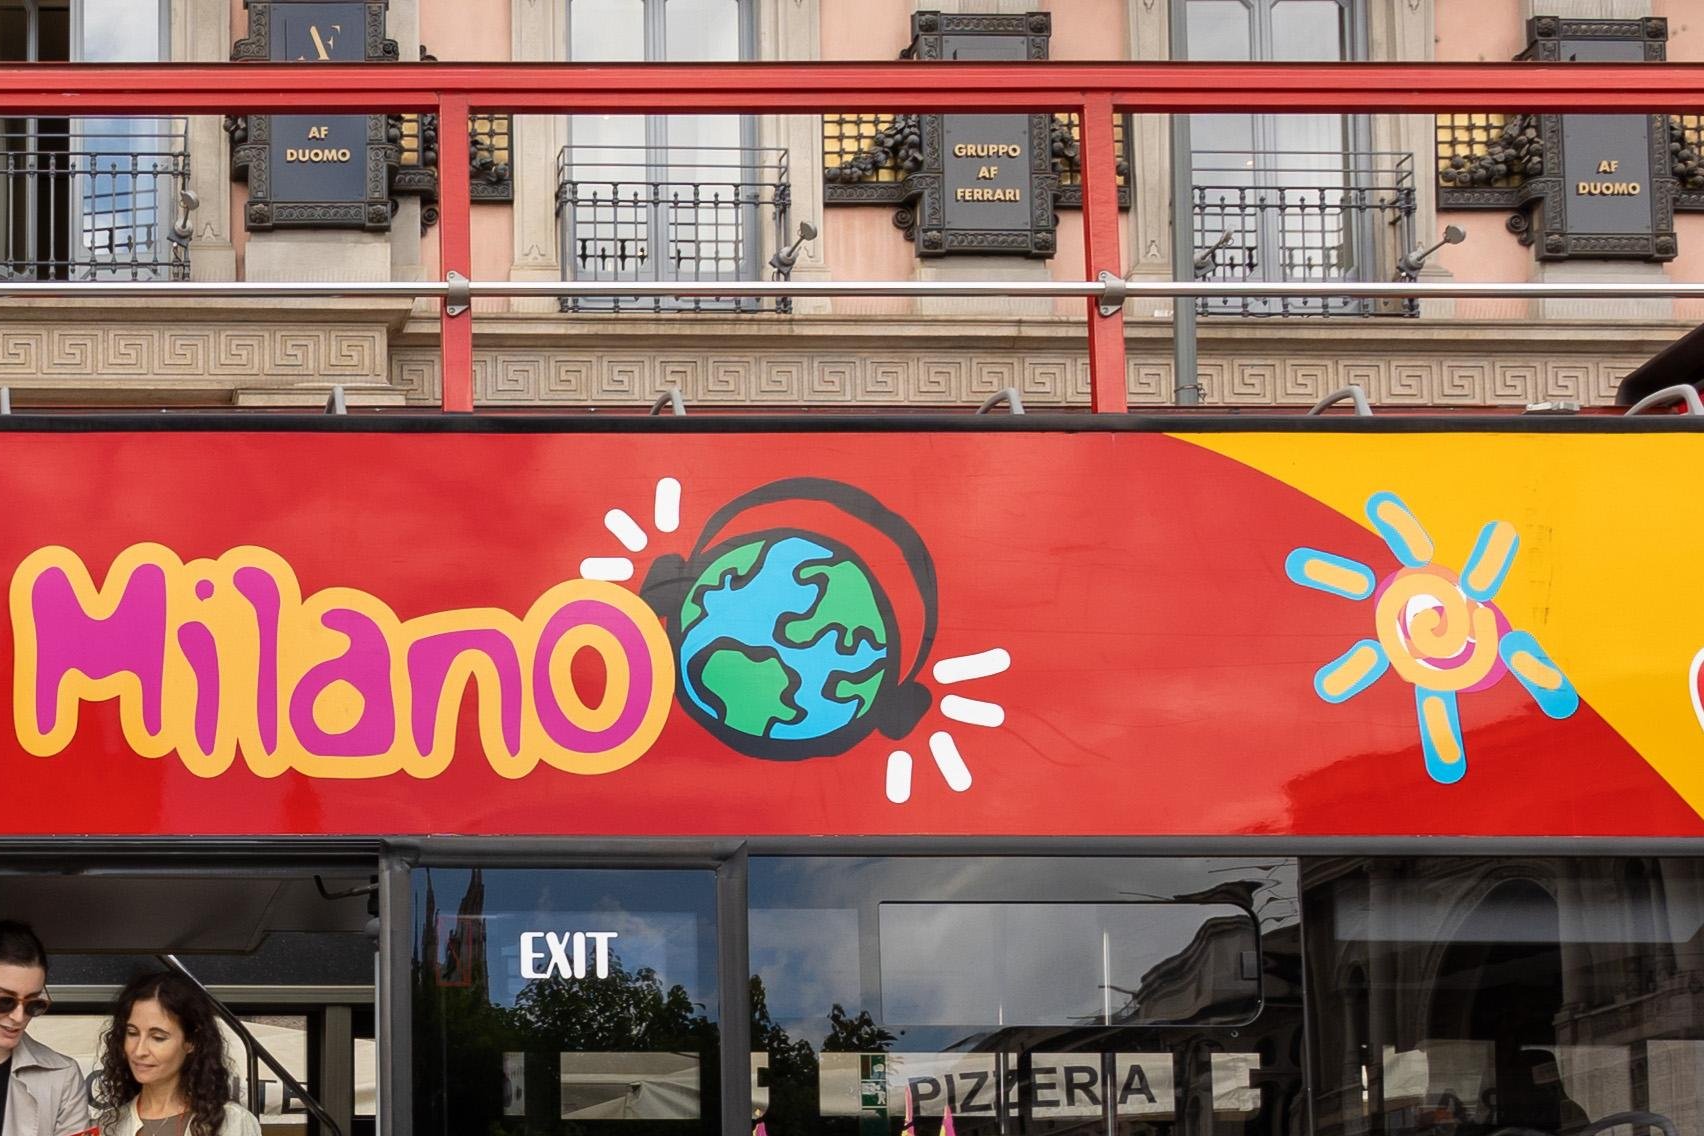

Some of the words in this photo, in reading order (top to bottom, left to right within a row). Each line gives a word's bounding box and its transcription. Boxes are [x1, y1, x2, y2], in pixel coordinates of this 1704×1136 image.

[308, 126, 329, 139] AF
[286, 149, 351, 162] DUOMO
[954, 144, 1020, 158] GRUPPO
[978, 166, 998, 180] AF
[1599, 160, 1619, 174] AF
[956, 188, 1021, 203] FERRARI
[1577, 181, 1641, 196] DUOMO
[520, 931, 618, 979] EXIT
[908, 1064, 1158, 1116] PIZZERA
